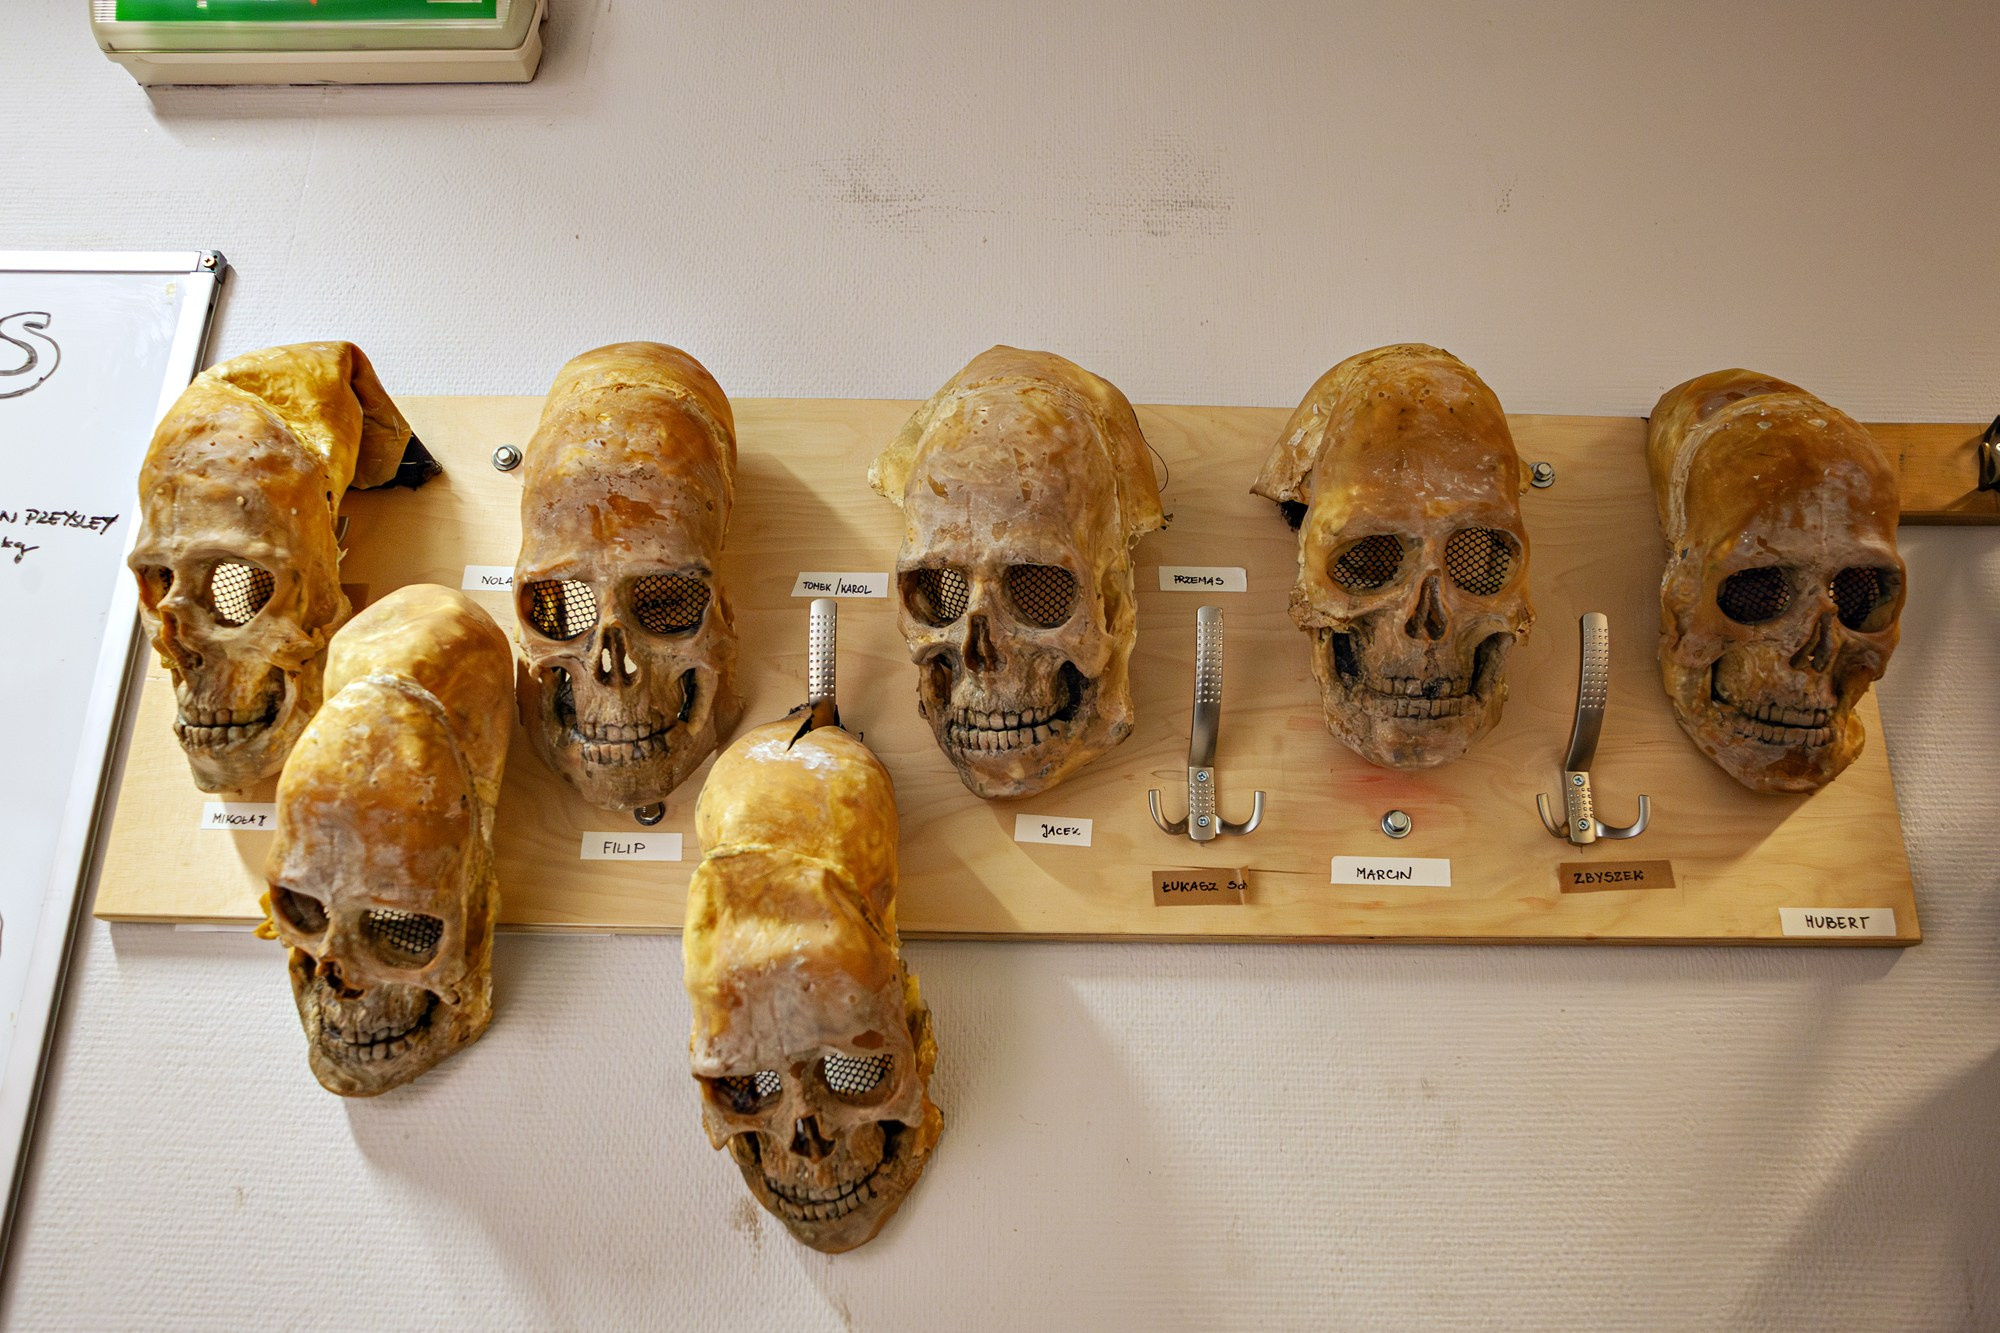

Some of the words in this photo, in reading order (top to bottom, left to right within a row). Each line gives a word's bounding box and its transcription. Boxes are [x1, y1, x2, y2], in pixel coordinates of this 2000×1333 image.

[1174, 575, 1224, 586] PRZEMAS
[603, 841, 646, 854] FILIP
[1356, 866, 1412, 880] MARCIN
[1574, 870, 1644, 884] ZBYSZEK
[1161, 881, 1218, 892] ŁUKASZ
[1805, 915, 1870, 929] HUBERT
